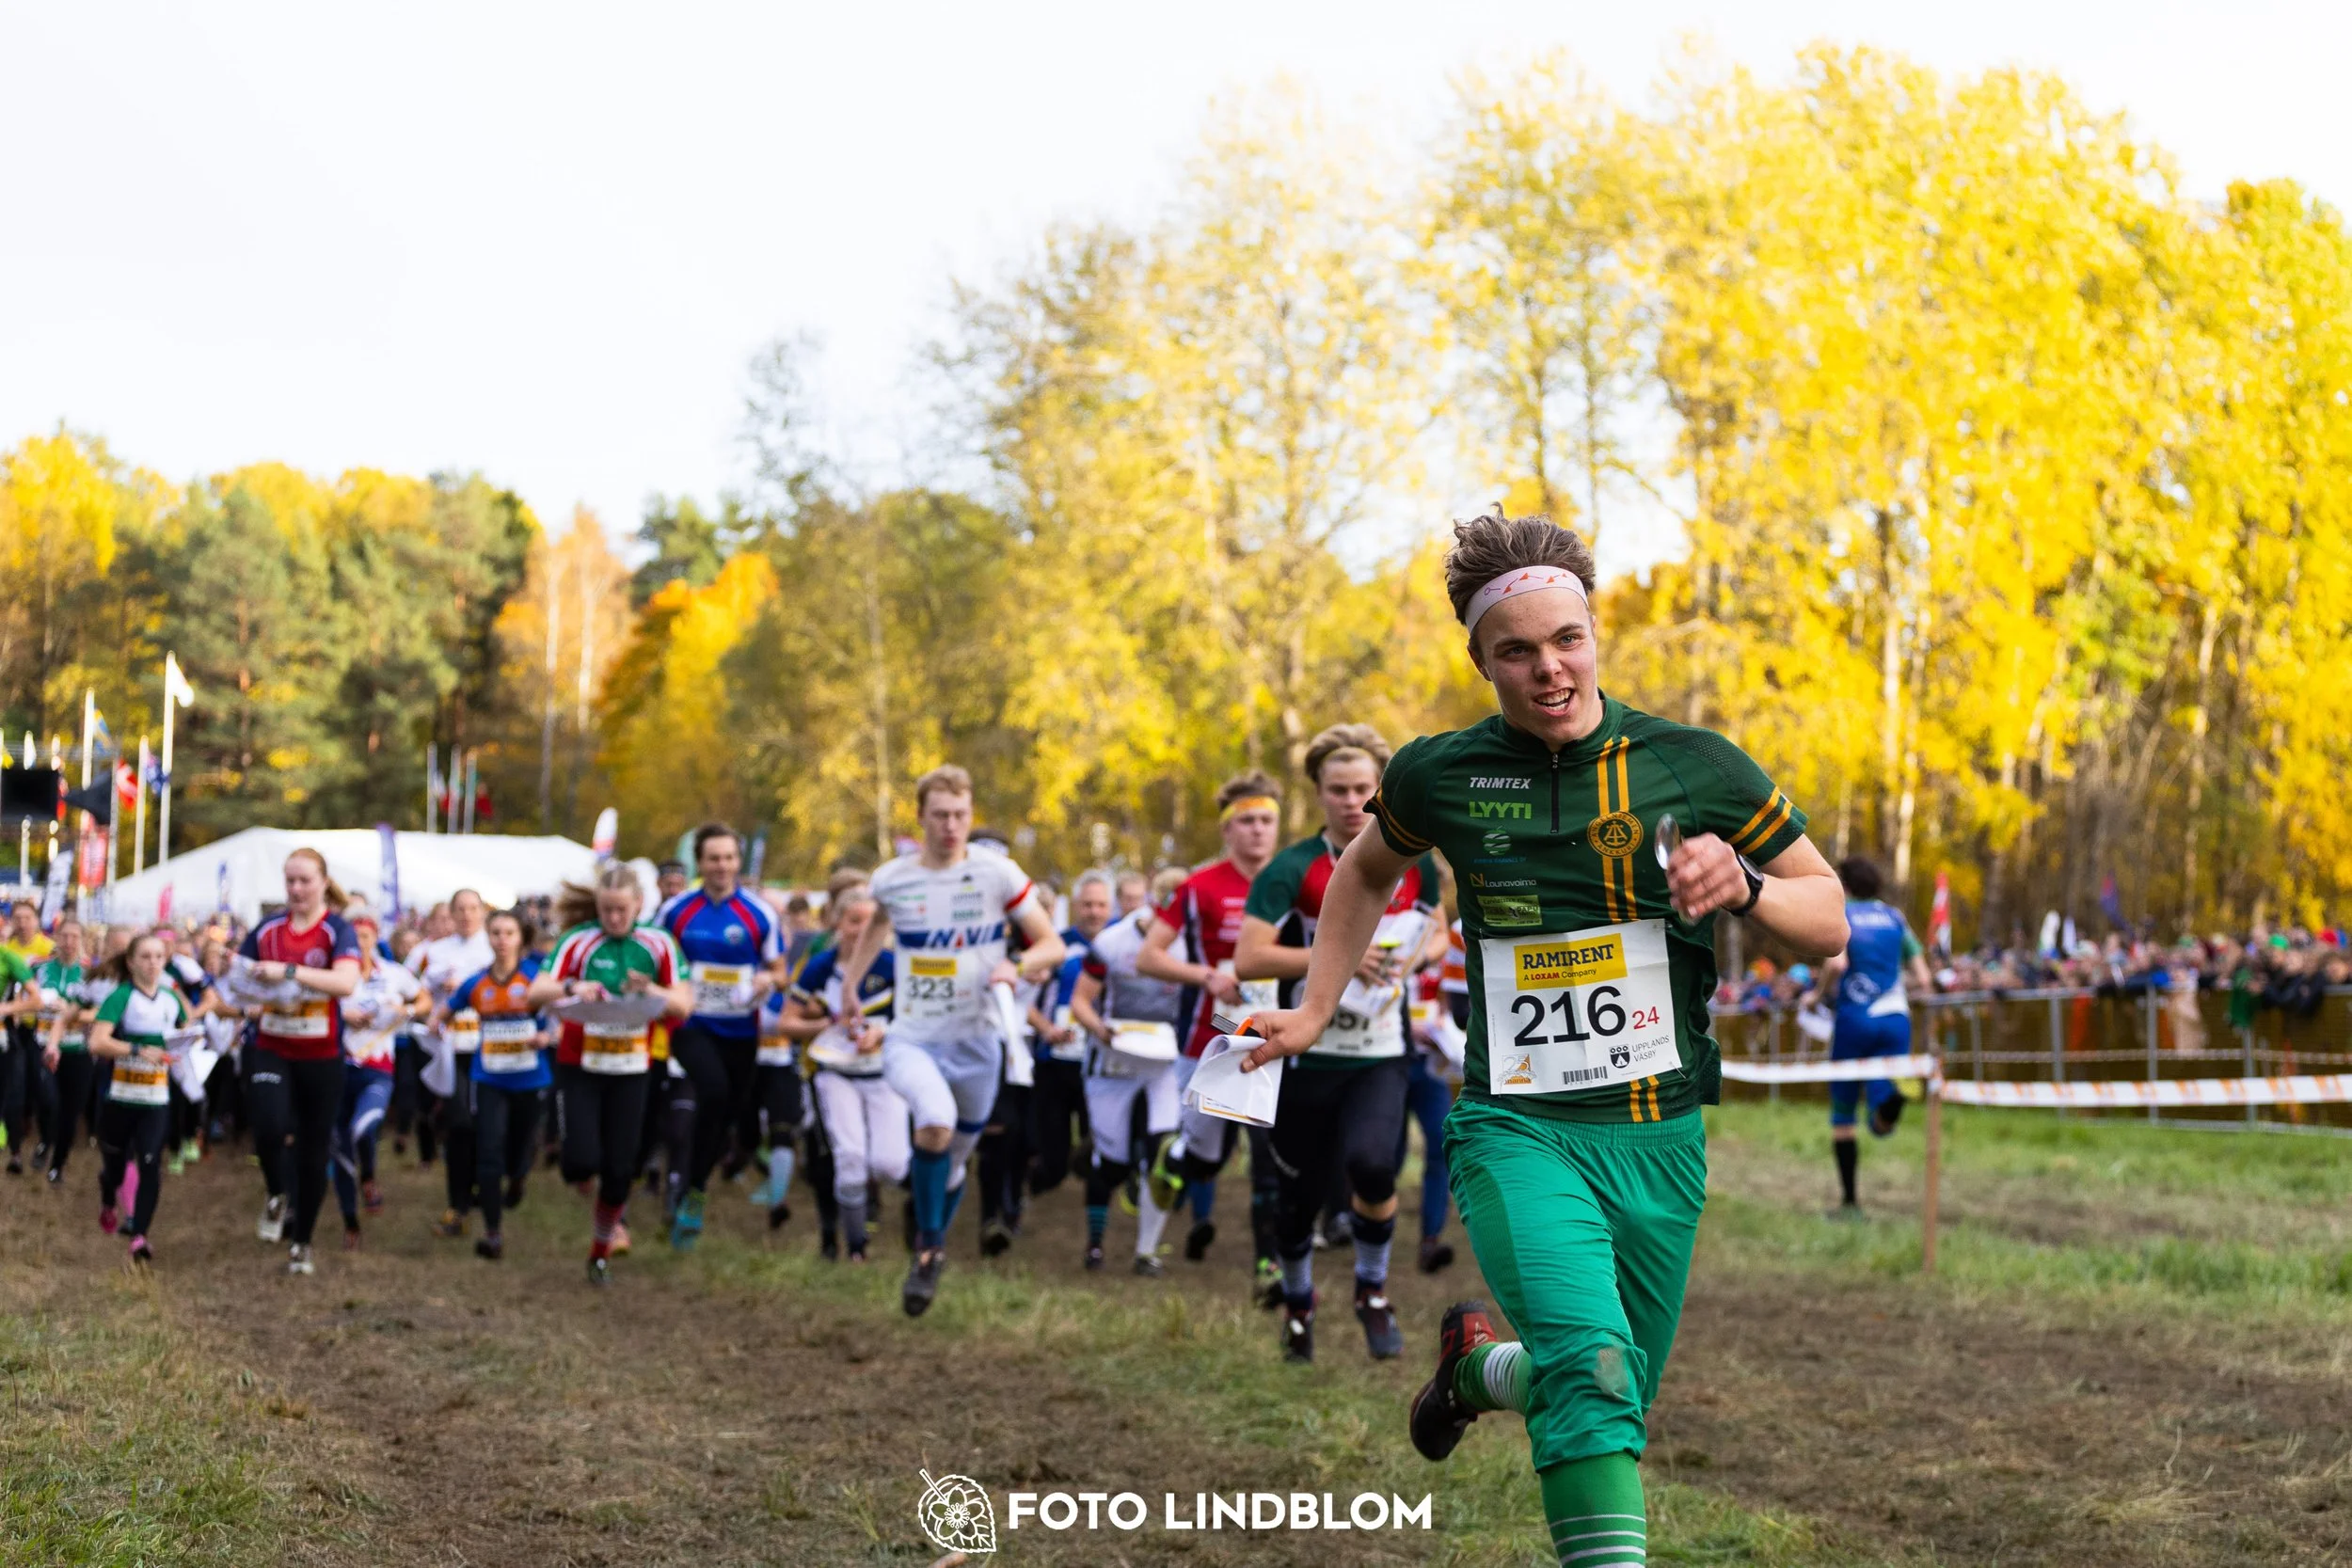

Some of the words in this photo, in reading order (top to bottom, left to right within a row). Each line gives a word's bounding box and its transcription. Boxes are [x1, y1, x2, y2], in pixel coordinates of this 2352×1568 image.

[1470, 777, 1532, 789] TRIMTEX
[1469, 801, 1532, 819] LYYTI
[1523, 944, 1614, 970] RAMIRENT
[1562, 968, 1597, 979] Company
[907, 977, 954, 999] 323
[1511, 986, 1626, 1047] 216
[1632, 1006, 1660, 1030] 24
[1632, 1036, 1670, 1053] UPPLANDS
